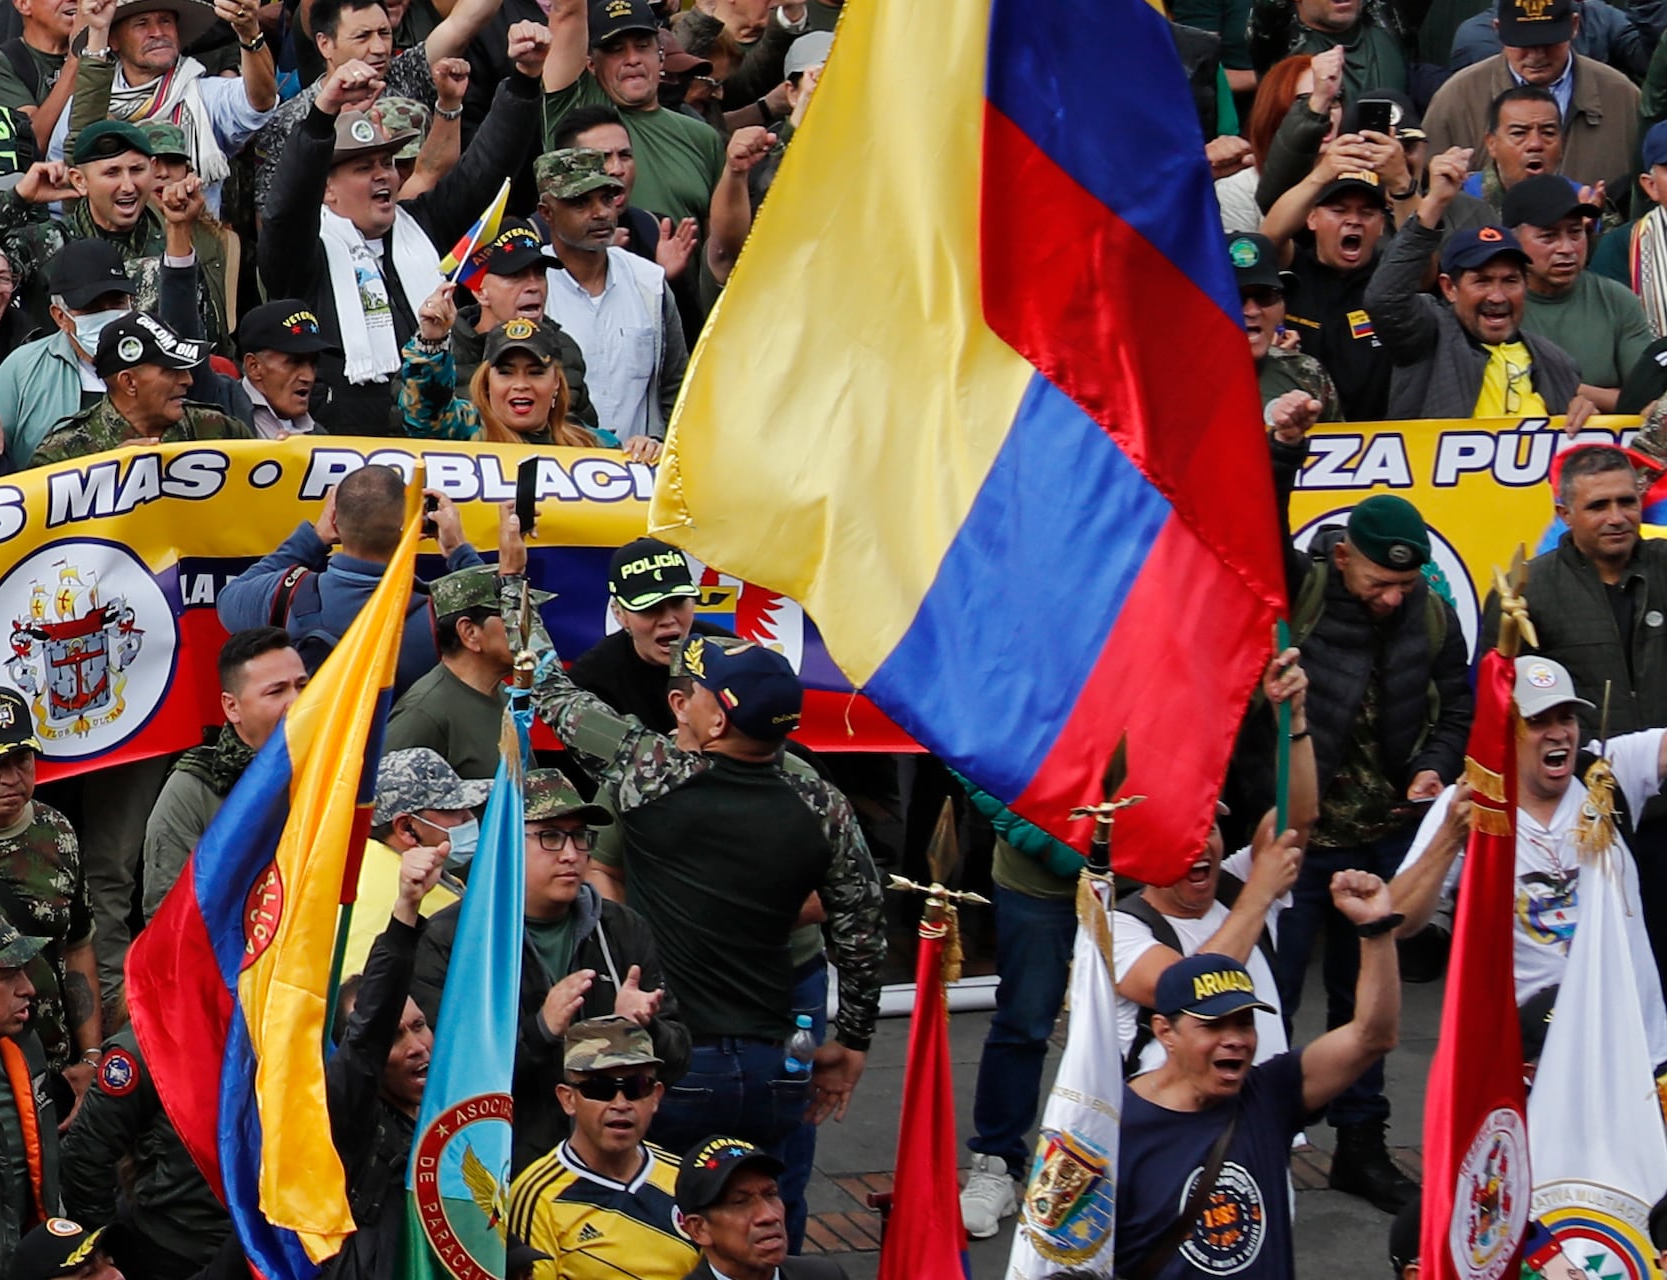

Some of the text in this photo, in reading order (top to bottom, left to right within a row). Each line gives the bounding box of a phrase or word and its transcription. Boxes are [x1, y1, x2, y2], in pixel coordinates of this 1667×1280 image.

[300, 449, 656, 503] PBLACI
[1295, 431, 1413, 489] ZA
[49, 451, 229, 526] MAS
[620, 551, 684, 581] POLICÍA
